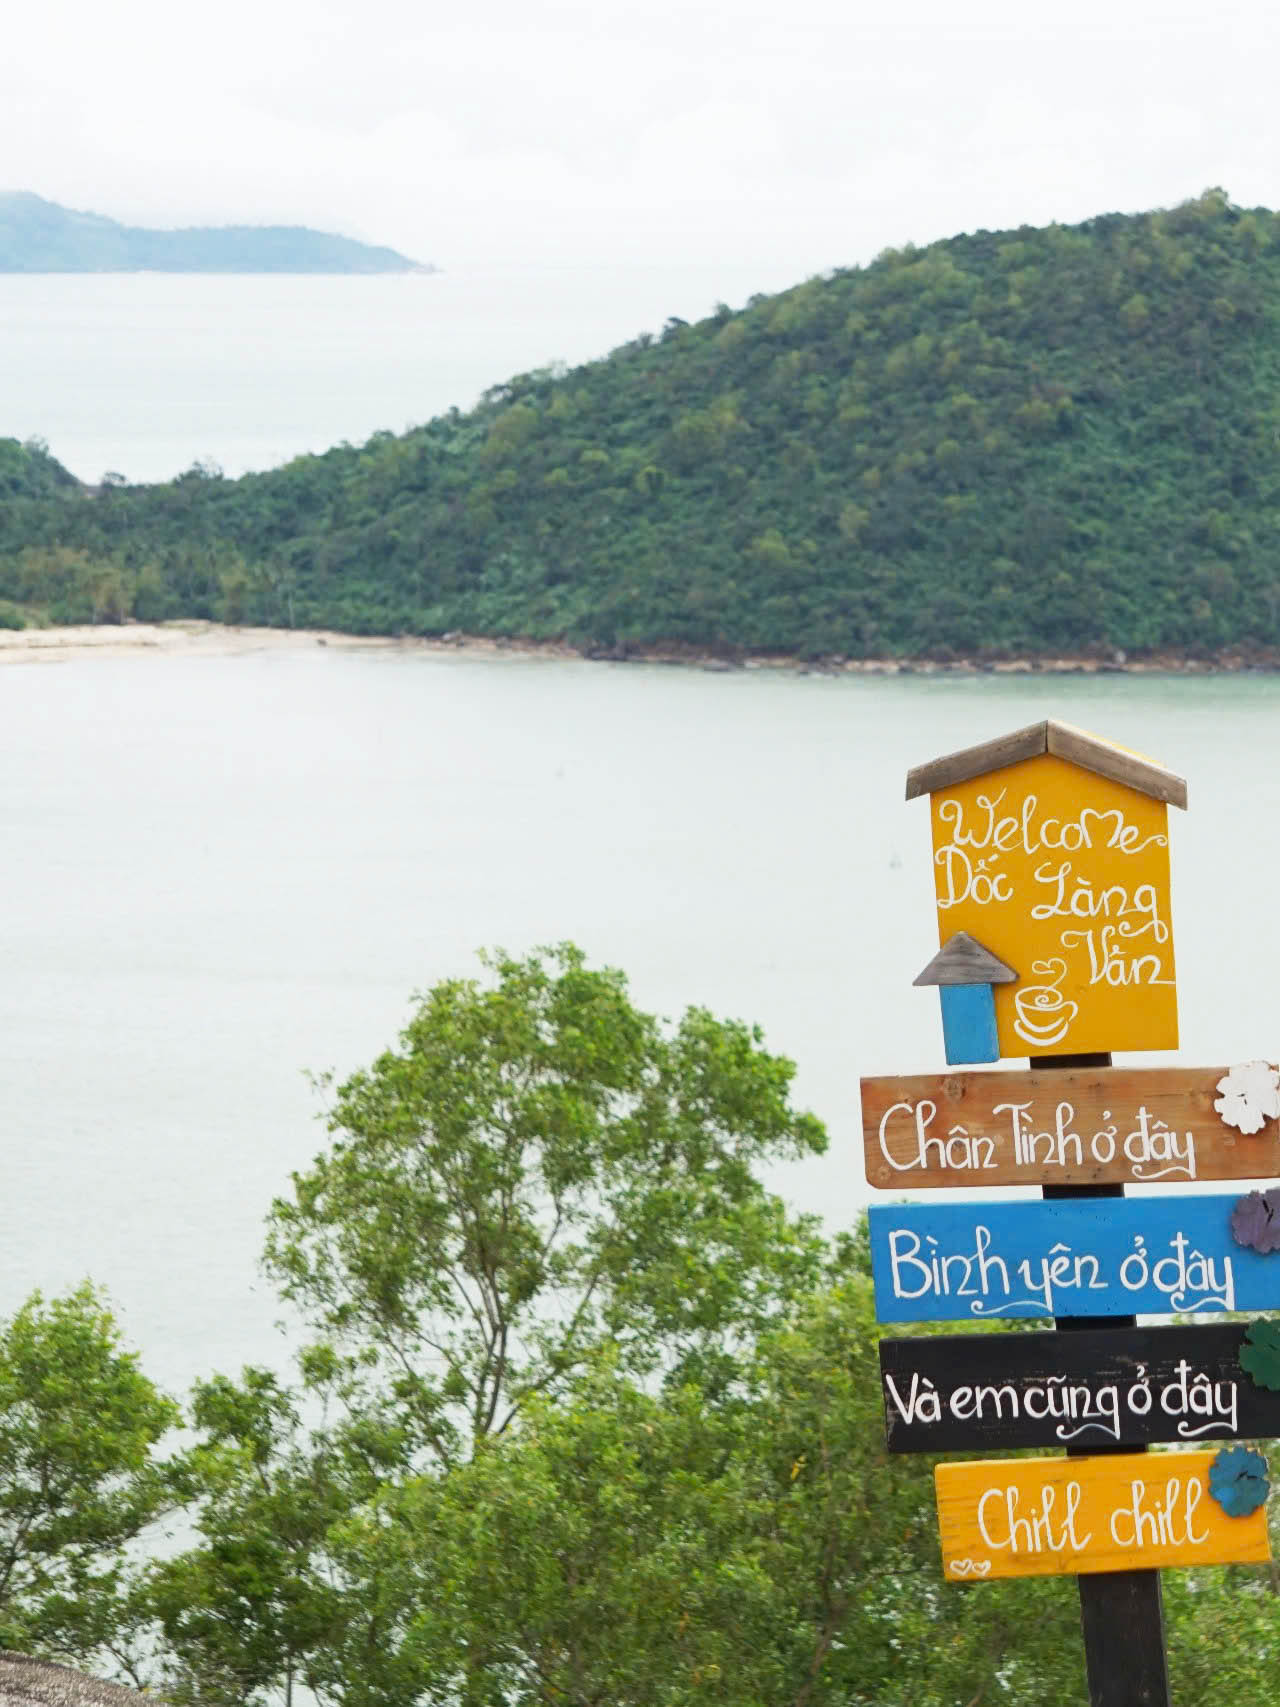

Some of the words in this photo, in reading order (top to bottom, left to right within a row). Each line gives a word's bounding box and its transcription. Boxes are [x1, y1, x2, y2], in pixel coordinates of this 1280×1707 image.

[939, 786, 1169, 855] Welcome
[935, 845, 1013, 909] Dốc
[1031, 862, 1169, 943] Làng
[1061, 924, 1176, 986] Vân
[879, 1100, 998, 1171] Chân
[993, 1101, 1083, 1167] Tình
[1091, 1110, 1118, 1163] ở
[1124, 1106, 1196, 1179] đây
[889, 1225, 1011, 1299] Bình
[970, 1242, 1109, 1316] yên
[1120, 1235, 1149, 1291] ở
[1152, 1231, 1235, 1313] đây
[885, 1372, 942, 1425] Và
[949, 1384, 1019, 1420] em
[1023, 1374, 1121, 1440] cũng
[1127, 1365, 1153, 1416] ở
[1160, 1359, 1238, 1438] đây
[977, 1480, 1092, 1553] Chill
[1110, 1476, 1210, 1548] chill
